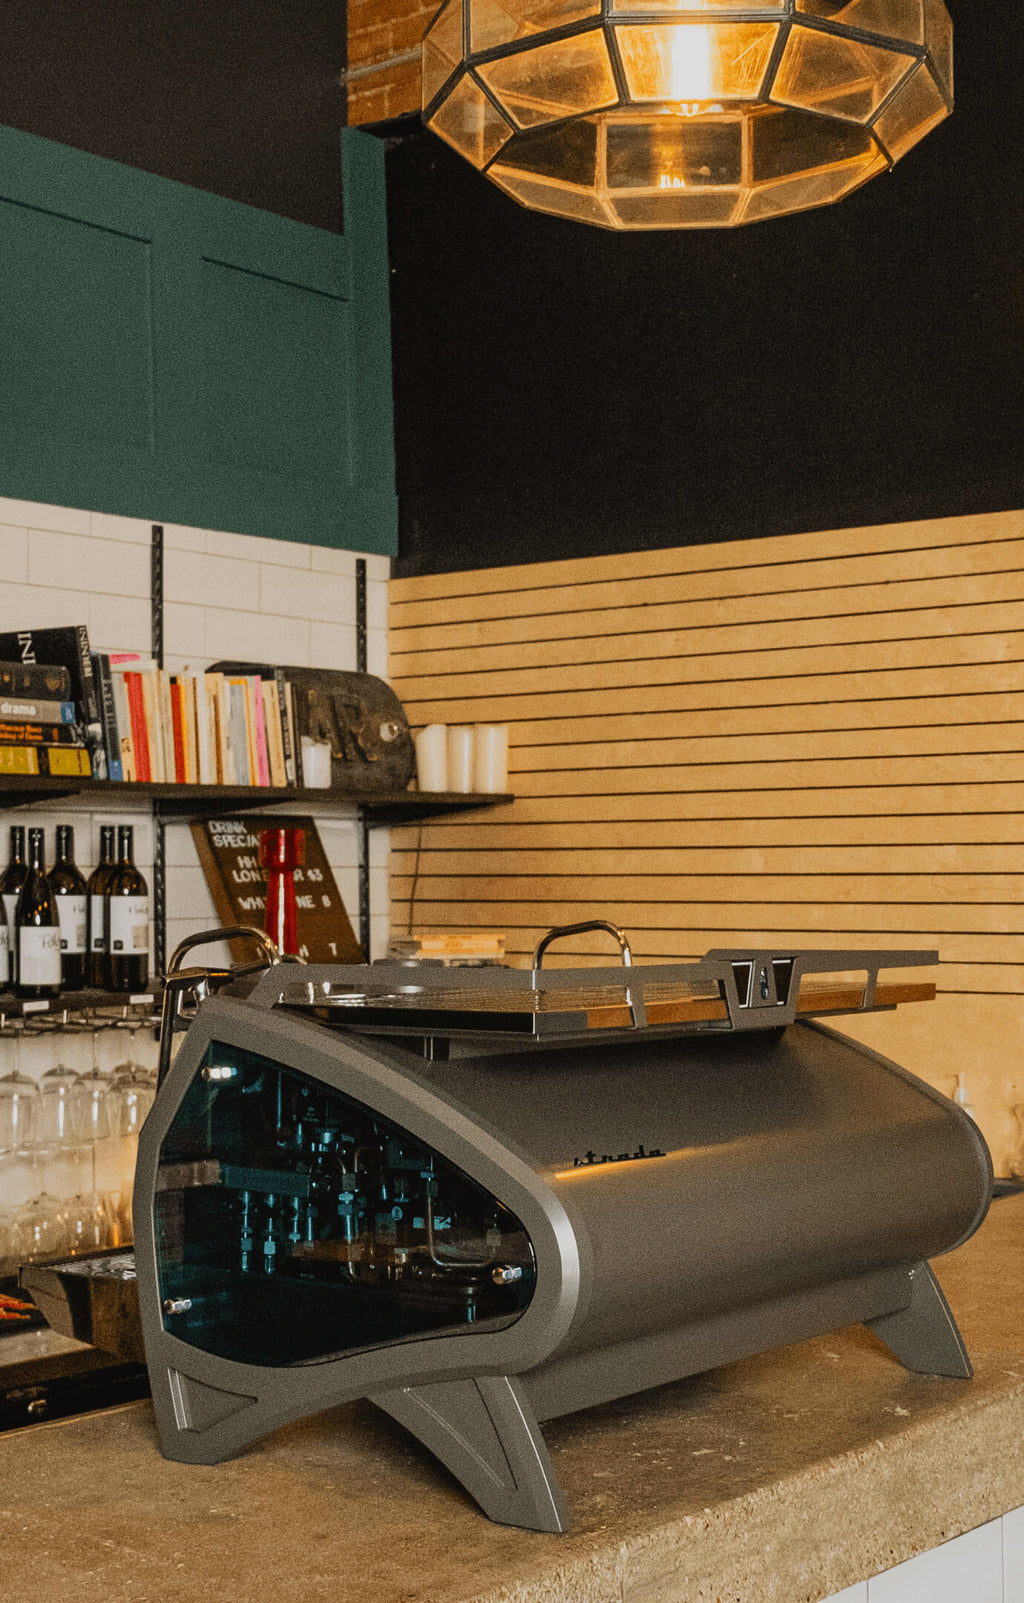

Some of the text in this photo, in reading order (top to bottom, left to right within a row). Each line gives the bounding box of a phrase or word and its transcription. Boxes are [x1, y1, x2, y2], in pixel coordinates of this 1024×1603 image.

[1, 702, 36, 716] drama
[208, 820, 248, 834] DRINK
[212, 834, 261, 848] SPECIA
